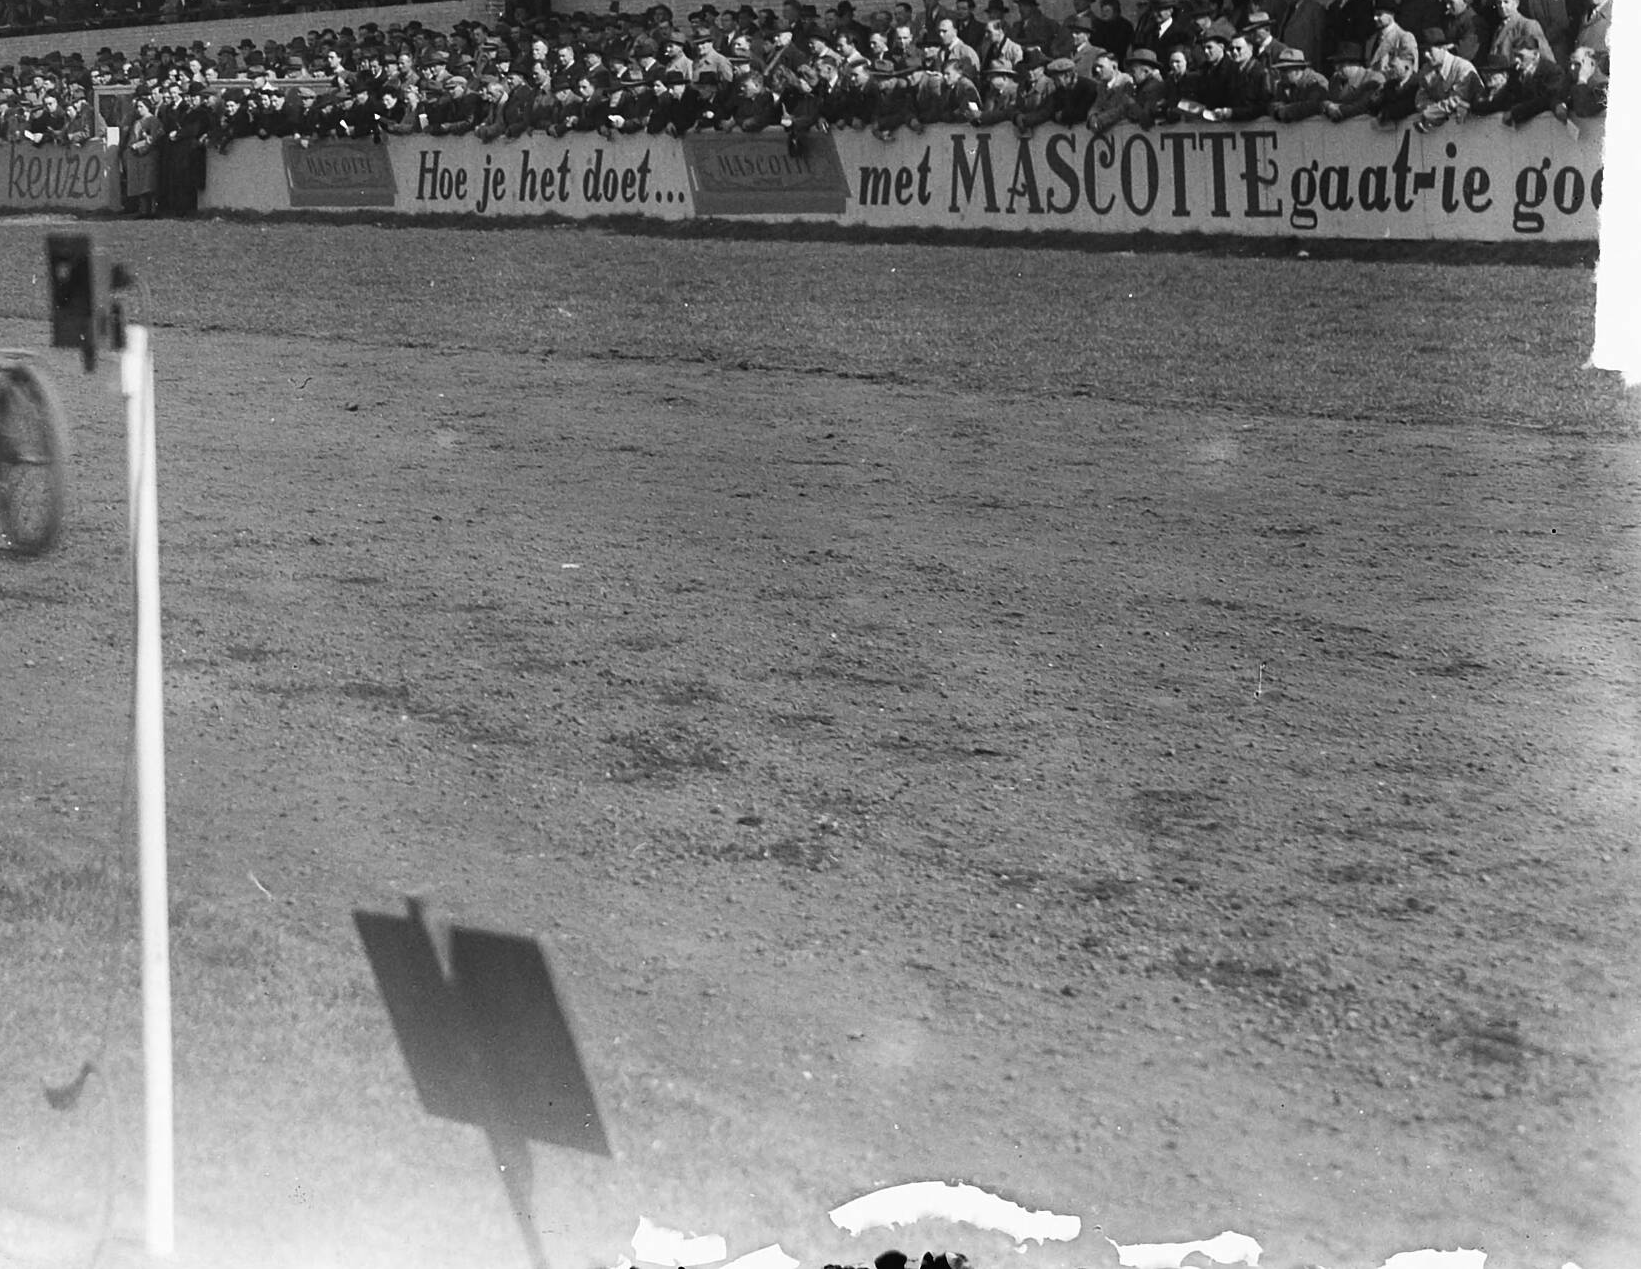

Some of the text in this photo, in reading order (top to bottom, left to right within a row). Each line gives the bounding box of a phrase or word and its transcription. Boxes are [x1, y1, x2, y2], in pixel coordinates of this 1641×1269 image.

[8, 140, 103, 199] keuze
[415, 147, 686, 214] Hoe je het doet...
[858, 145, 932, 206] met
[948, 130, 1284, 218] MASCOTTE
[1289, 129, 1493, 231] gaat-ie
